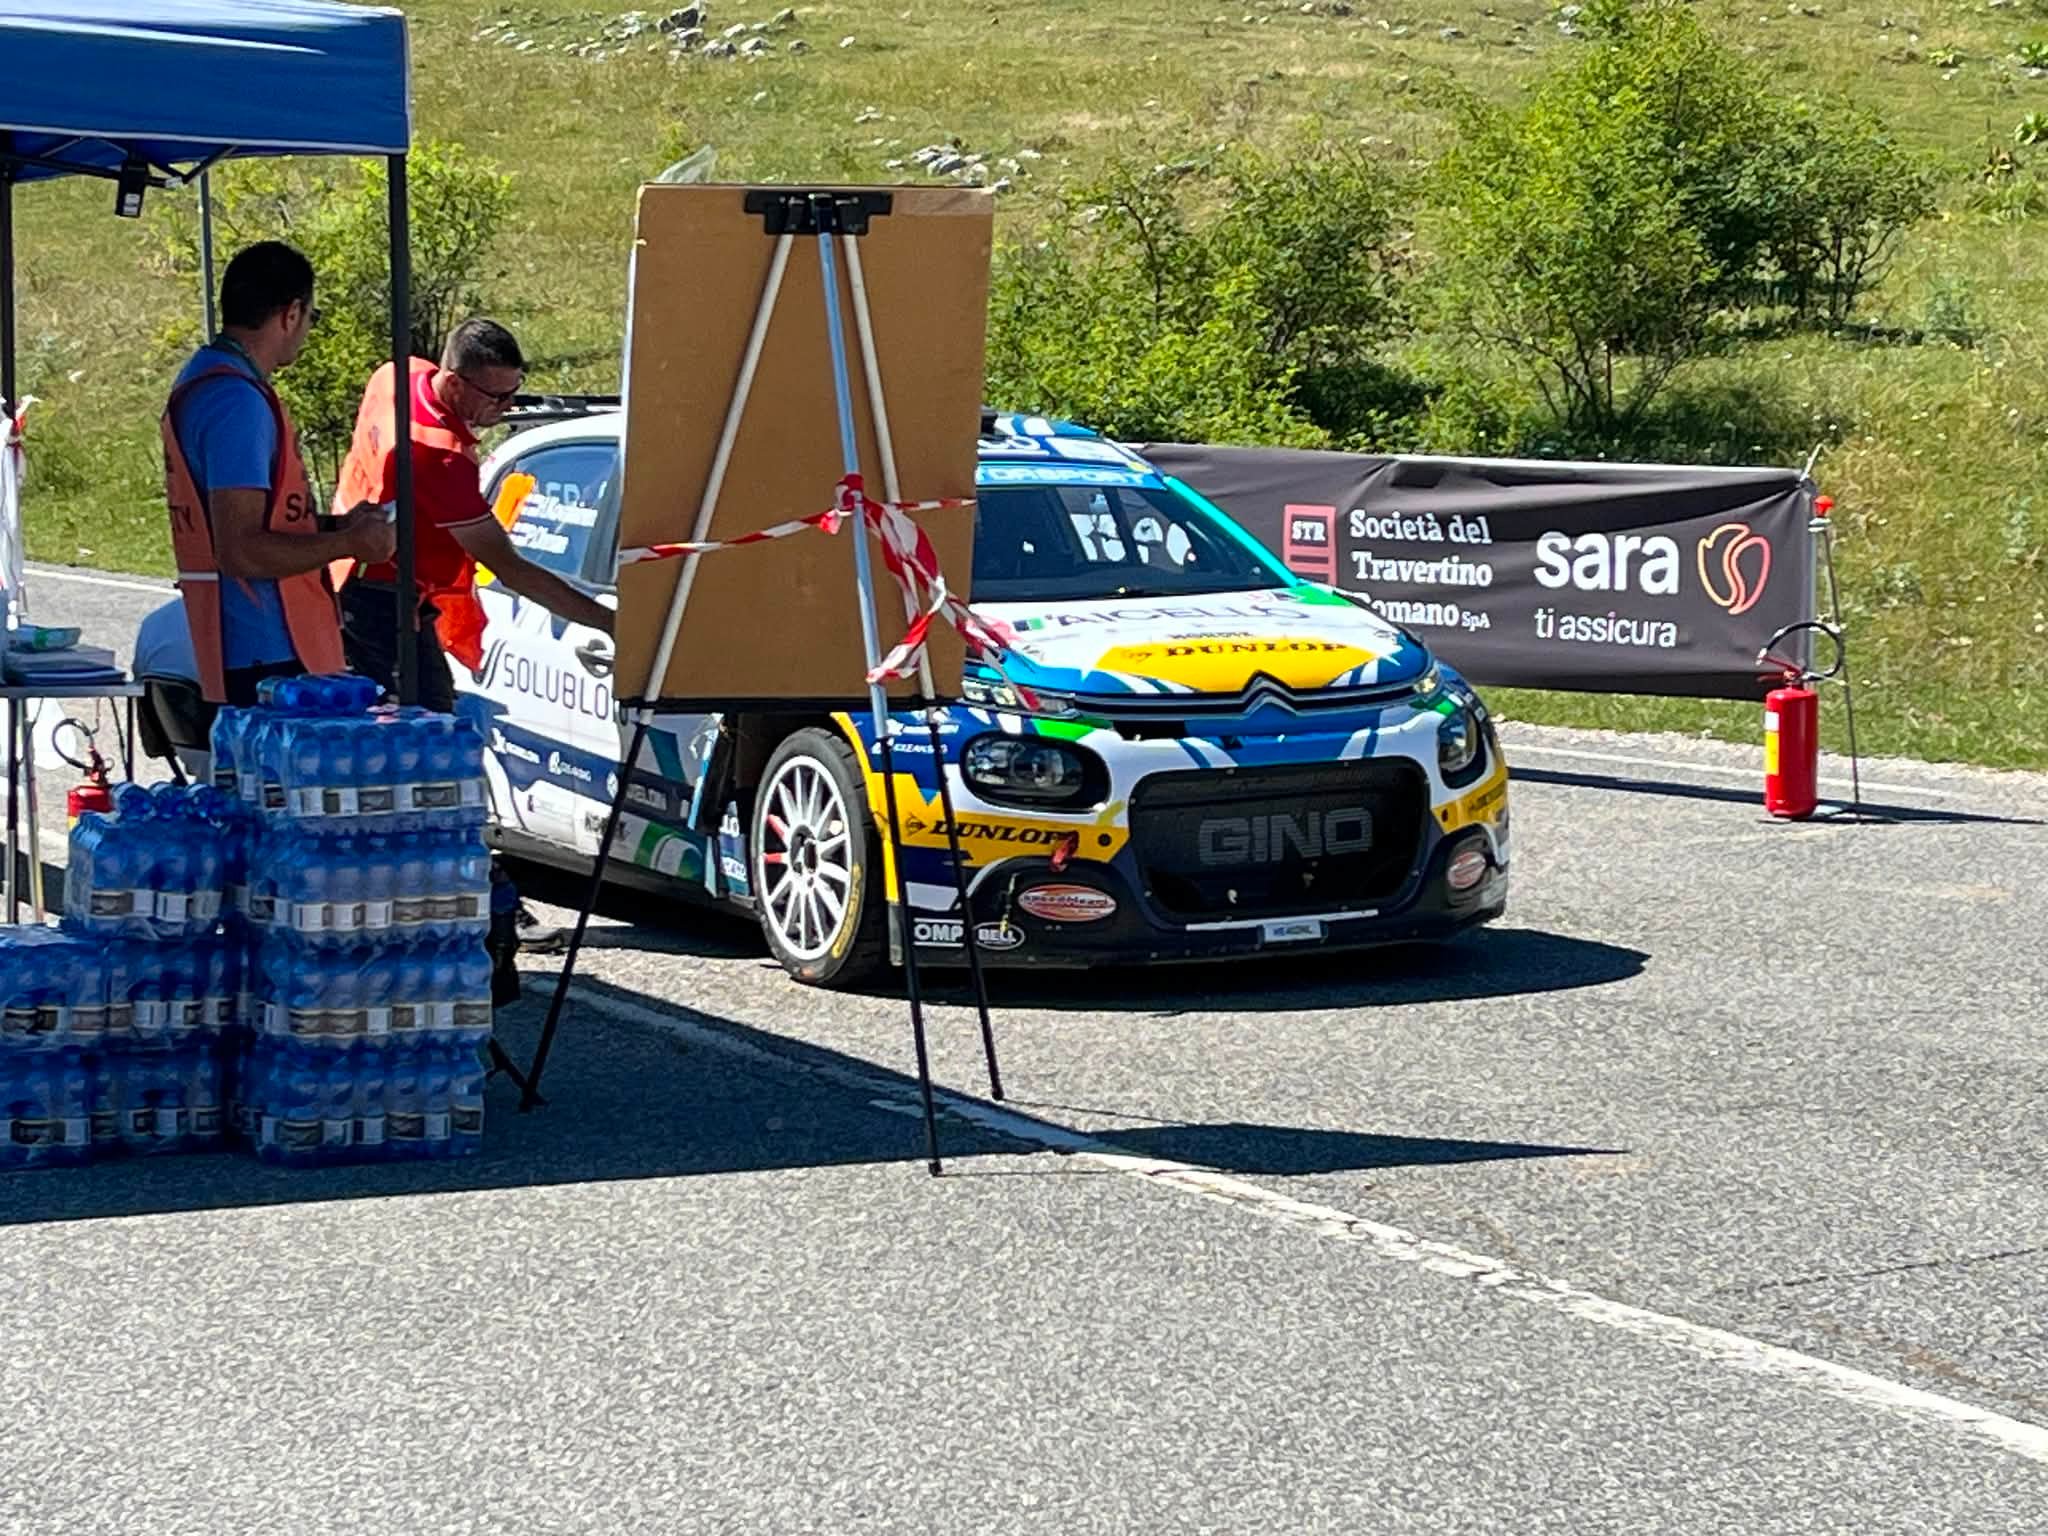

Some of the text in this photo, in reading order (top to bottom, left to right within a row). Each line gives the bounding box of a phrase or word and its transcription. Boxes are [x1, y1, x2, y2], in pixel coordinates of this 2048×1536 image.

[1292, 520, 1325, 541] STR
[1350, 509, 1492, 544] Società del
[1352, 551, 1493, 586] Travertino
[1533, 531, 1679, 594] sara
[1356, 592, 1490, 631] omano SpA
[1534, 608, 1677, 648] ti assicura
[1167, 643, 1347, 656] DUNLOP
[1199, 807, 1373, 865] GINO
[914, 924, 964, 942] OMP
